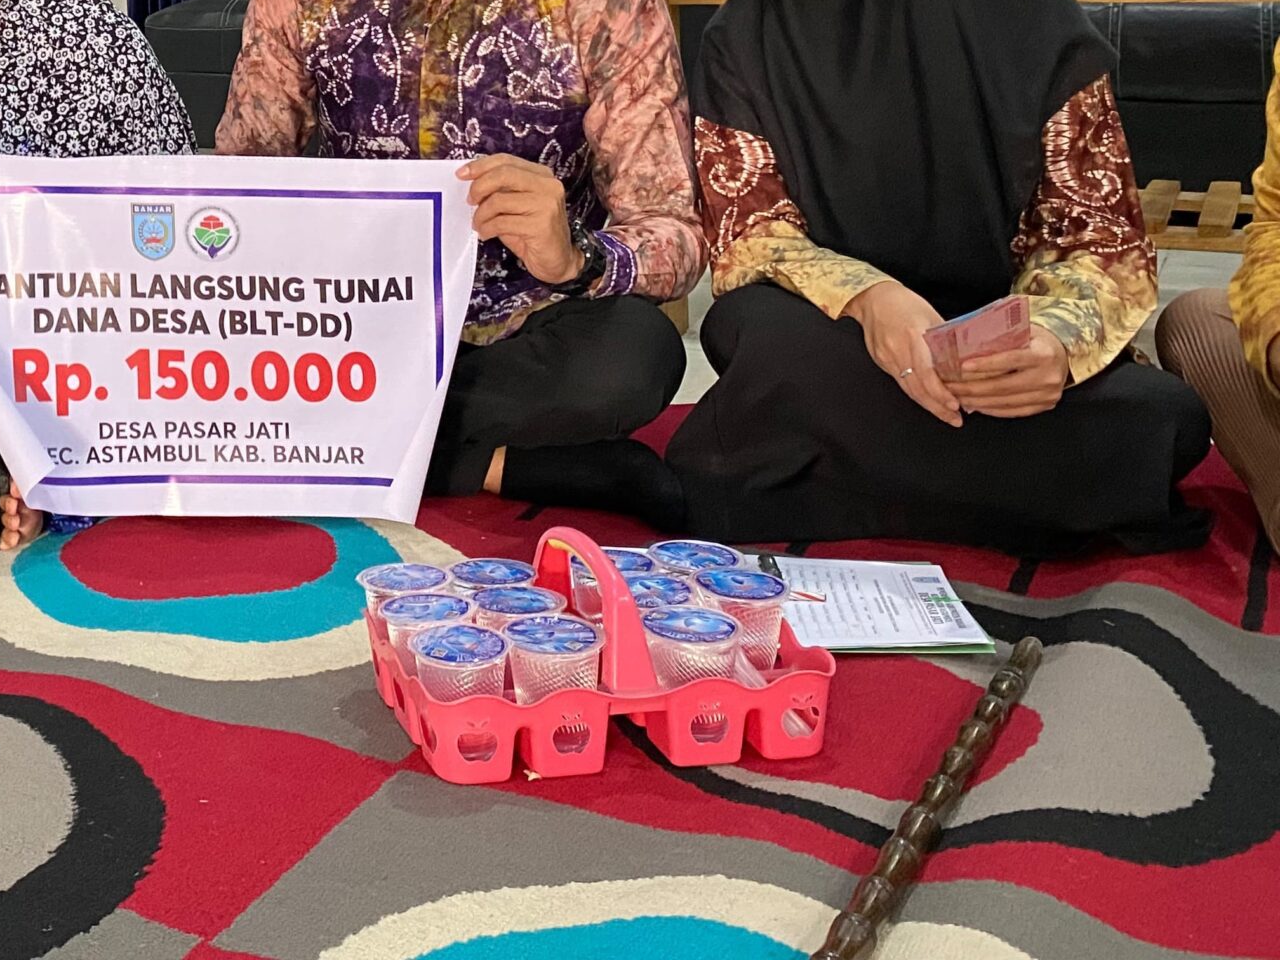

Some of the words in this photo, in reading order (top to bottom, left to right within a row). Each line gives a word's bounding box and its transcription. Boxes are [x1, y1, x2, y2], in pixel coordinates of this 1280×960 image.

[134, 205, 172, 213] BANJAR
[130, 273, 305, 302] LANGSUNG
[313, 276, 413, 304] TUNAI
[33, 307, 122, 334] DANA
[129, 308, 210, 335] DESA
[219, 309, 353, 342] (BLT-DD)
[12, 348, 109, 416] Rp.
[125, 348, 377, 403] 150.000
[99, 421, 157, 440] DESA
[165, 421, 236, 439] PASAR
[245, 421, 290, 439] JATI
[45, 447, 79, 465] EC.
[86, 444, 207, 464] ASTAMBUL
[214, 444, 266, 463] KAB.
[273, 445, 365, 464] BANJAR
